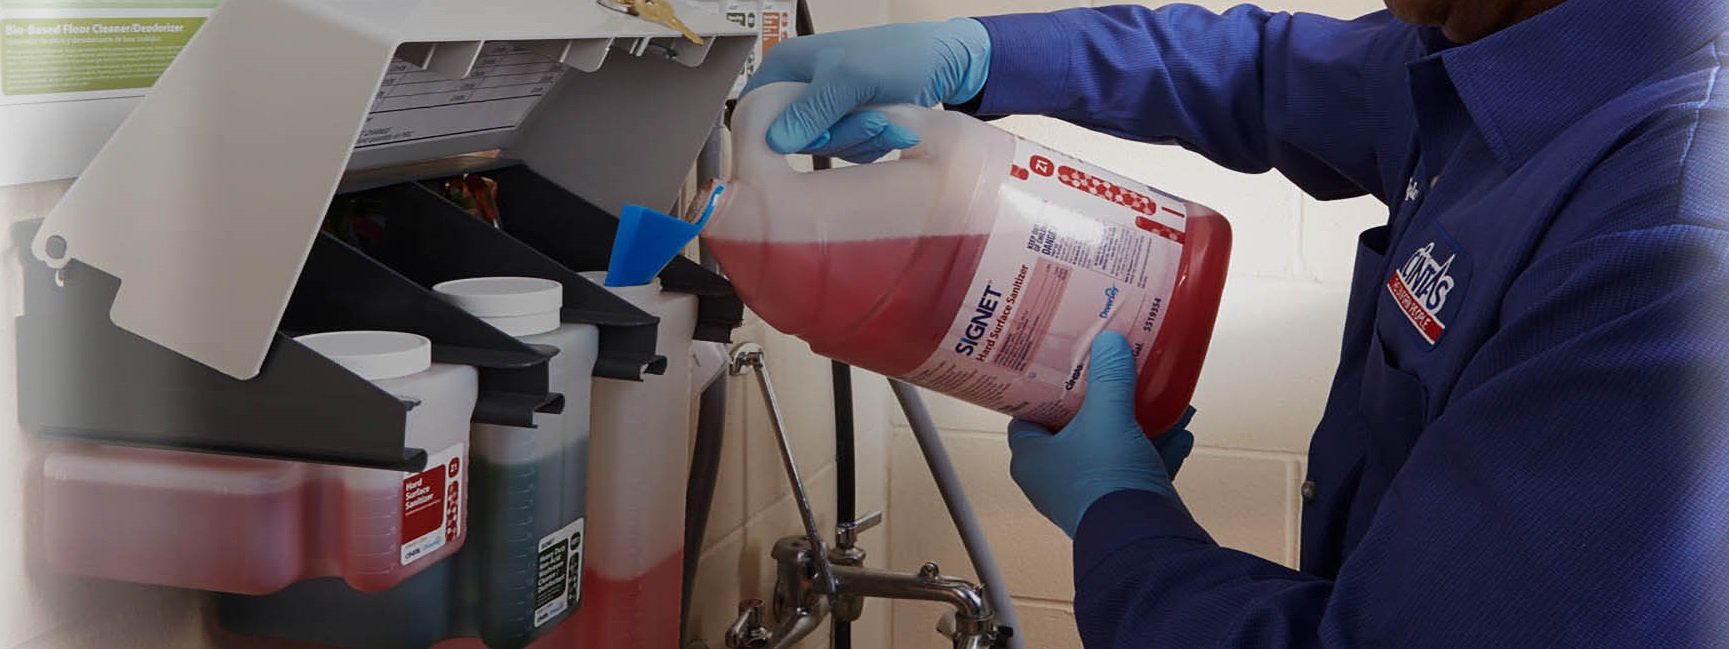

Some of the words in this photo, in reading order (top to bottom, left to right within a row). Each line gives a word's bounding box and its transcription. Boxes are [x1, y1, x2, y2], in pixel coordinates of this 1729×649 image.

[5, 24, 61, 35] Bio-Based
[63, 24, 90, 34] Floor
[92, 23, 184, 34] Cleaner/Deodorizer
[1036, 160, 1049, 173] Z1
[1099, 286, 1119, 318] Diversey
[955, 285, 1002, 356] SIGNET
[976, 339, 996, 362] Hard
[990, 304, 1013, 340] Surface
[1006, 264, 1029, 305] Sanitizer
[406, 477, 423, 491] Hard
[406, 486, 431, 501] Surface
[405, 493, 435, 511] Sanitizer
